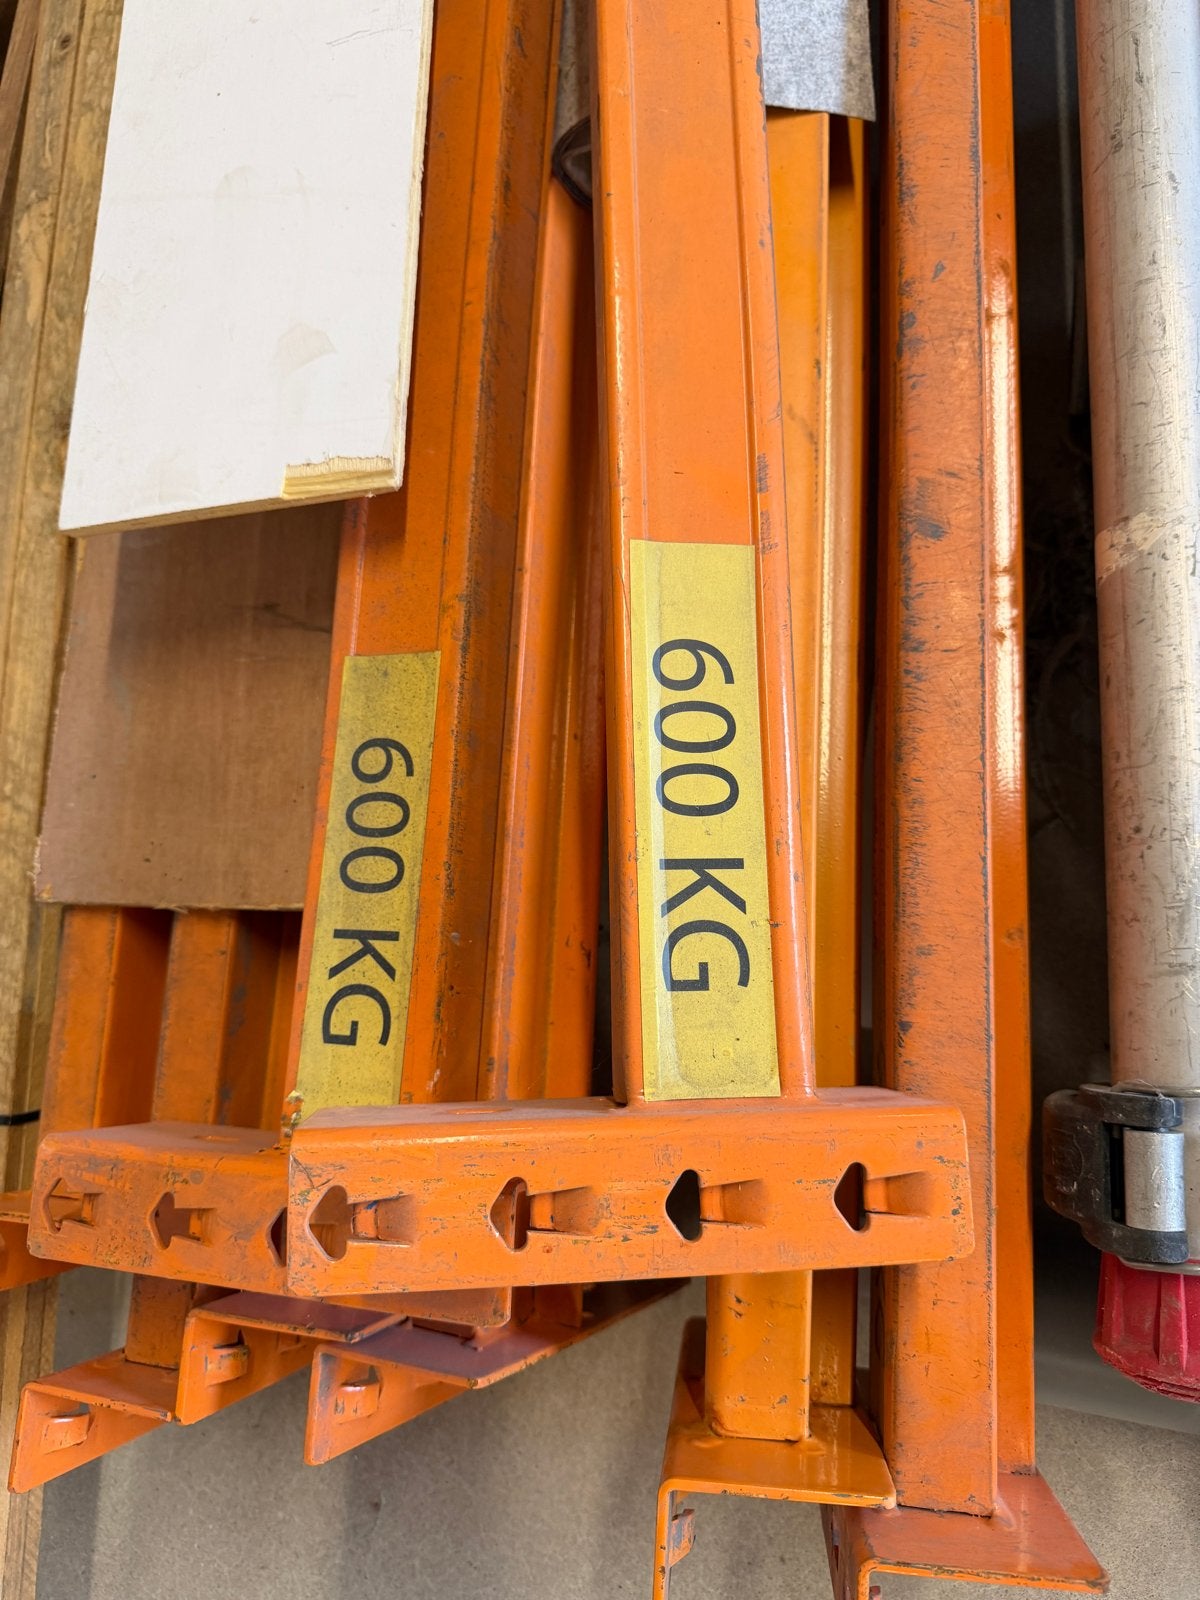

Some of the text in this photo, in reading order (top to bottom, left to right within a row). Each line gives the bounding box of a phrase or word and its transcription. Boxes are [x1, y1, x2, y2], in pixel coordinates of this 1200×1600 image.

[322, 737, 414, 1046] 600 KG
[652, 638, 750, 992] 600 KG
